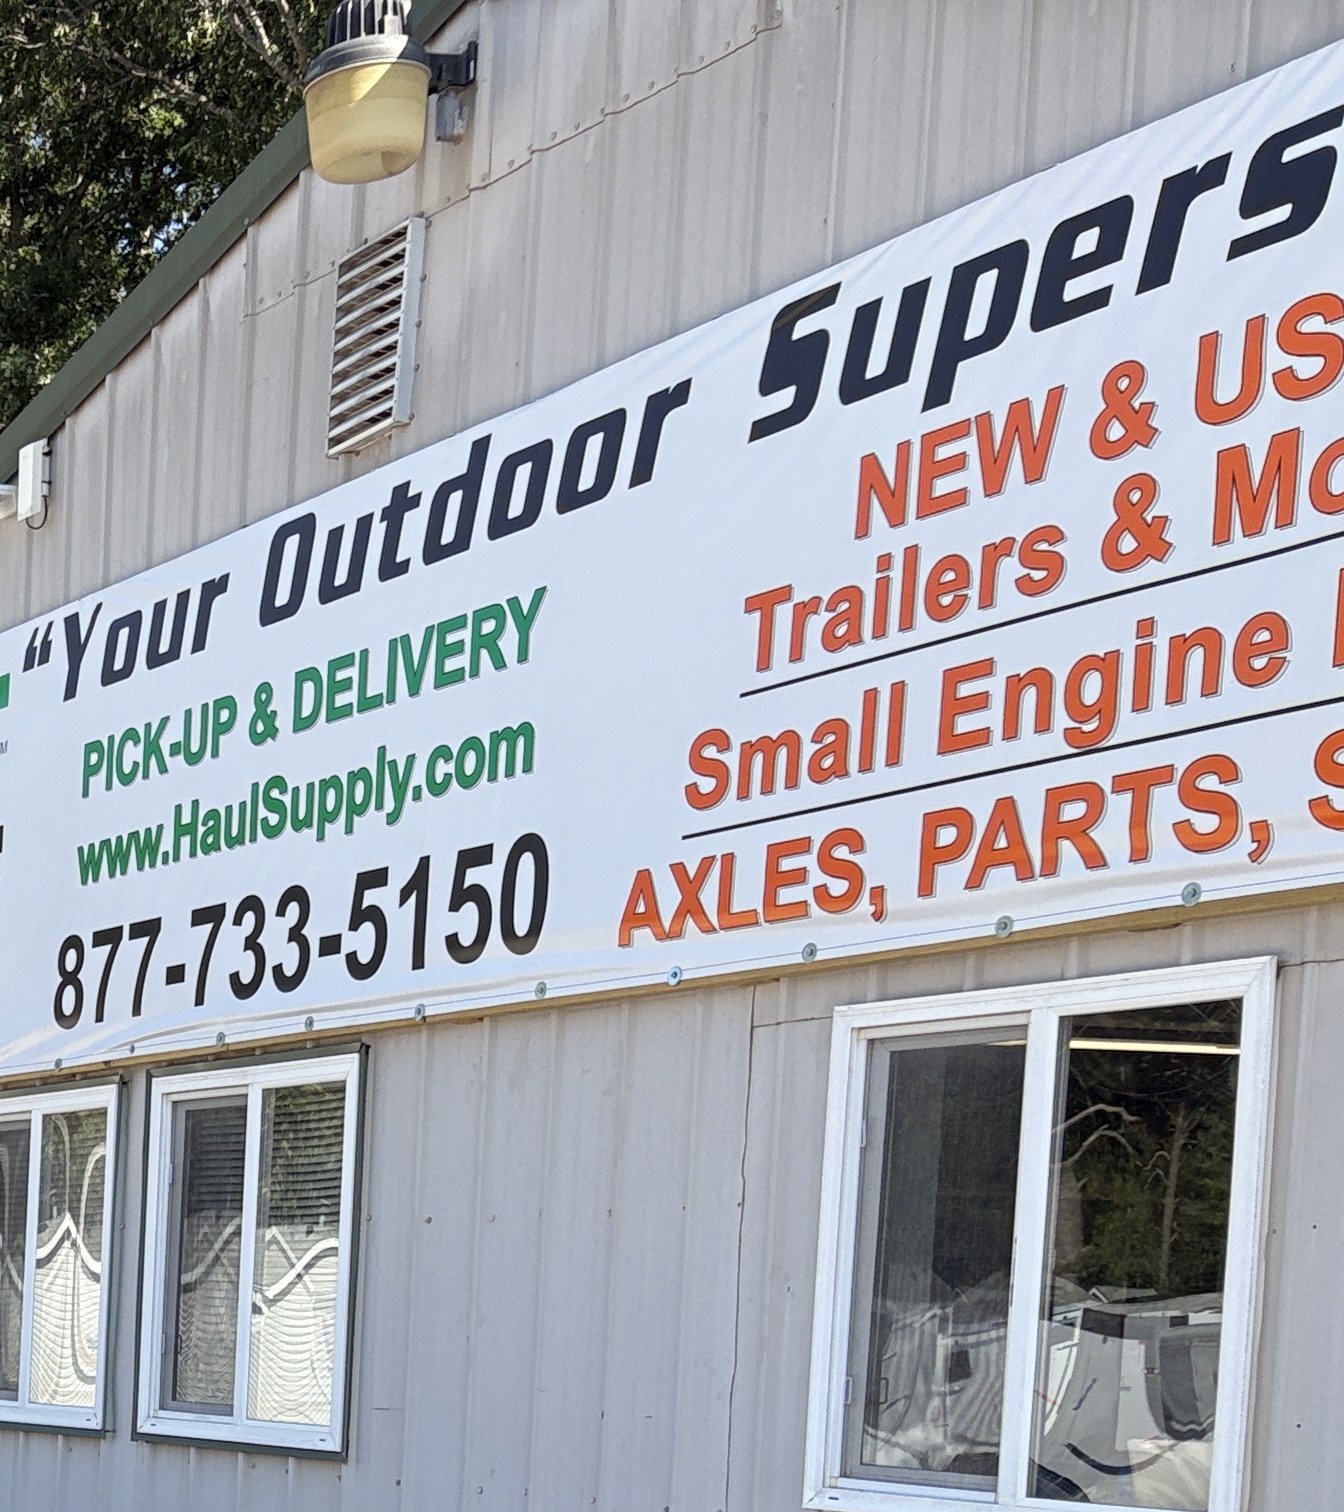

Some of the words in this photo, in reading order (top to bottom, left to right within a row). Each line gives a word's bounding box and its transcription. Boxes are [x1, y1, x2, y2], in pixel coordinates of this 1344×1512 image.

[259, 378, 693, 627] Outdoor
[748, 105, 1344, 444] Supers
[854, 385, 1067, 541] NEW
[1089, 359, 1157, 461] &
[1195, 293, 1344, 425] US
[743, 525, 1067, 674] Trailers
[1101, 472, 1173, 575] &
[82, 695, 238, 799] PICK-UP
[249, 691, 279, 746] &
[293, 585, 548, 734] DELIVERY
[683, 681, 908, 811] Small
[936, 611, 1292, 754] Engine
[77, 721, 537, 886] www.HaulSupply.com
[618, 827, 888, 949] AXLES,
[917, 754, 1274, 899] PARTS,
[54, 832, 550, 1029] 877-733-5150
